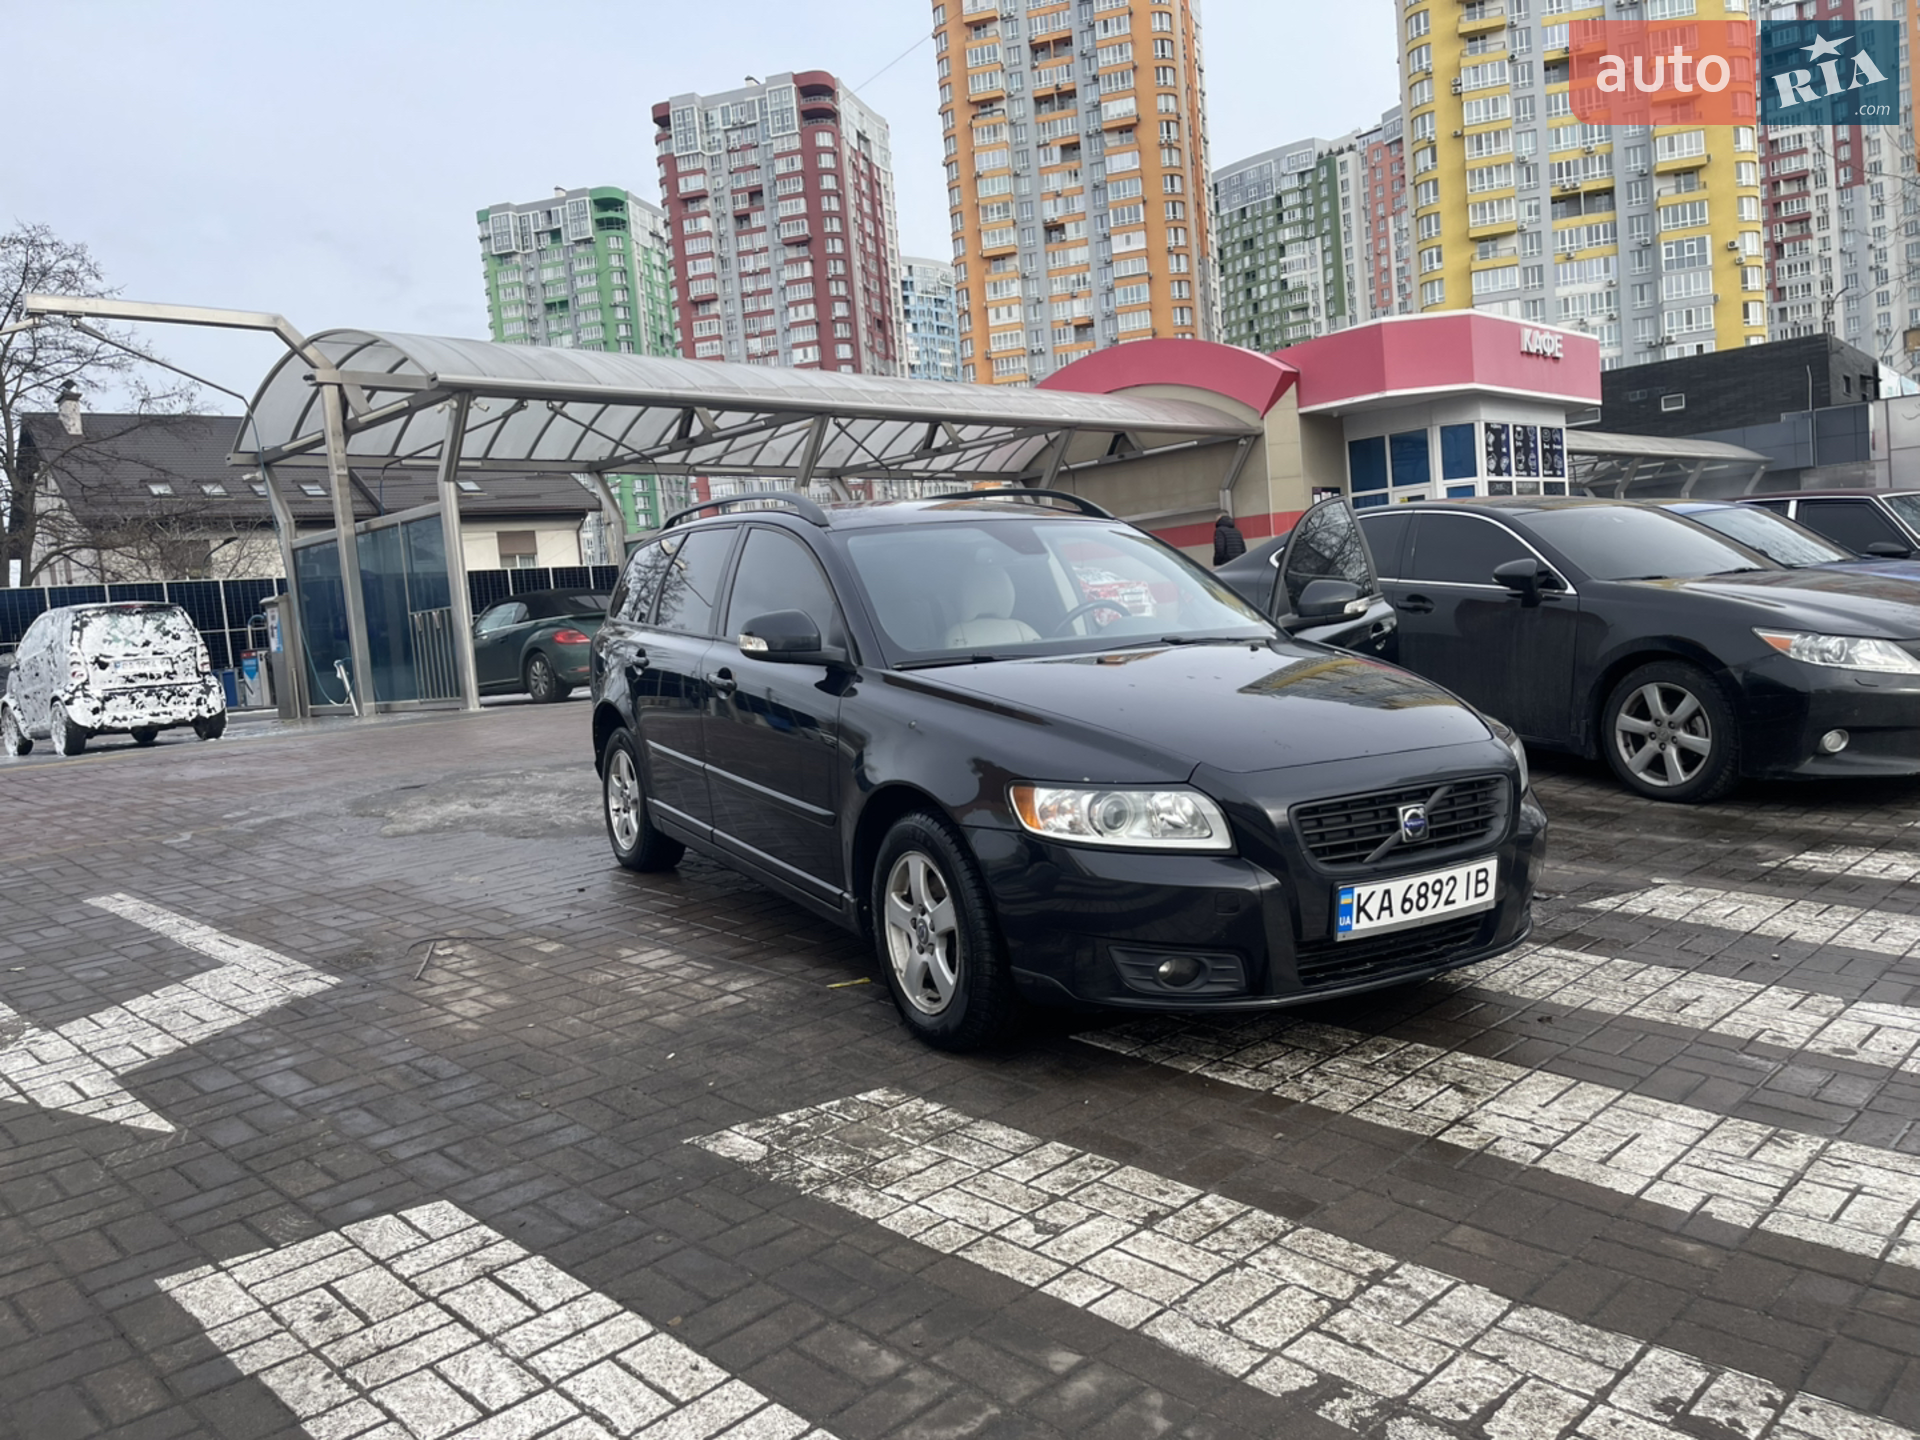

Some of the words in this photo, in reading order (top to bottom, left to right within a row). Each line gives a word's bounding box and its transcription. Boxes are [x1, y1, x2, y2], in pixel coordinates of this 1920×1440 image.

[1521, 328, 1564, 358] КАФЕ
[1355, 888, 1394, 924] KA
[1400, 875, 1457, 915] 6892
[1465, 867, 1489, 901] IB
[1339, 915, 1351, 926] UA
